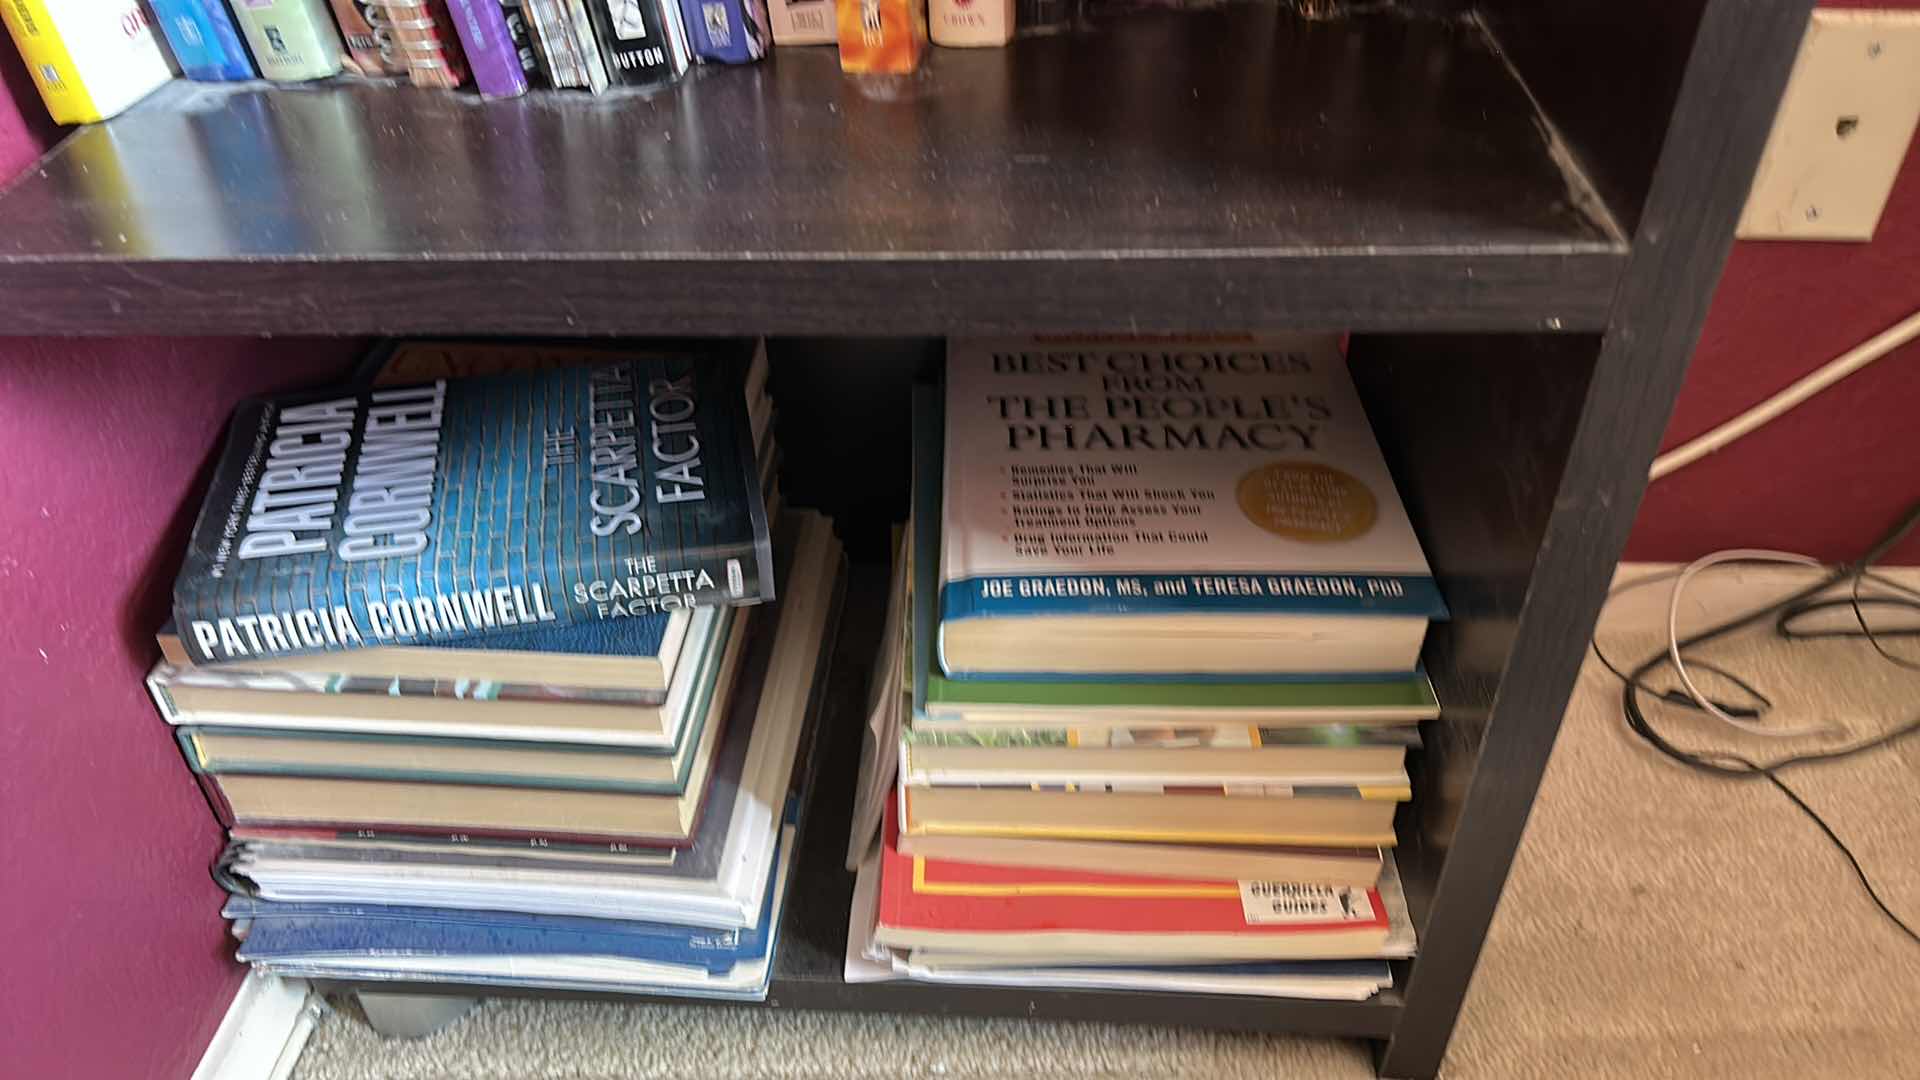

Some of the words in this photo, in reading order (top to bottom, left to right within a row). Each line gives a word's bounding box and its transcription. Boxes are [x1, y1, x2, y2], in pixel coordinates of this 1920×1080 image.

[612, 46, 665, 70] DUTTON
[991, 352, 1094, 373] BEST
[1106, 352, 1311, 373] CHOICES
[1101, 374, 1205, 393] FROM
[987, 396, 1088, 419] THE
[1104, 395, 1332, 420] PEOPLE'S
[543, 424, 576, 470] THE
[648, 375, 706, 504] FACTOR
[1008, 423, 1317, 449] PHARMACY
[588, 364, 643, 537] SCARPETTA
[238, 397, 358, 560] PATRICIA
[338, 379, 447, 561] CORNWELL
[1071, 476, 1095, 486] You
[1079, 464, 1106, 475] That
[1110, 464, 1138, 475] Will
[1080, 489, 1107, 500] That
[1111, 489, 1139, 500] Will
[1190, 489, 1216, 500] You
[1084, 504, 1116, 517] Help
[1135, 532, 1164, 543] That
[624, 555, 656, 576] THE
[573, 568, 715, 605] SCARPETTA
[981, 578, 1014, 598] JOE
[1019, 577, 1112, 598] GRAEDON,
[1153, 577, 1188, 596] and
[1192, 576, 1264, 596] TERESA
[1267, 576, 1364, 598] GRAEDON,
[597, 592, 698, 620] FACTOR
[191, 604, 364, 660] PATRICIA
[368, 582, 556, 641] CORNWELL
[1250, 880, 1335, 899] GUERRILLA
[1272, 899, 1327, 914] GUIDES
